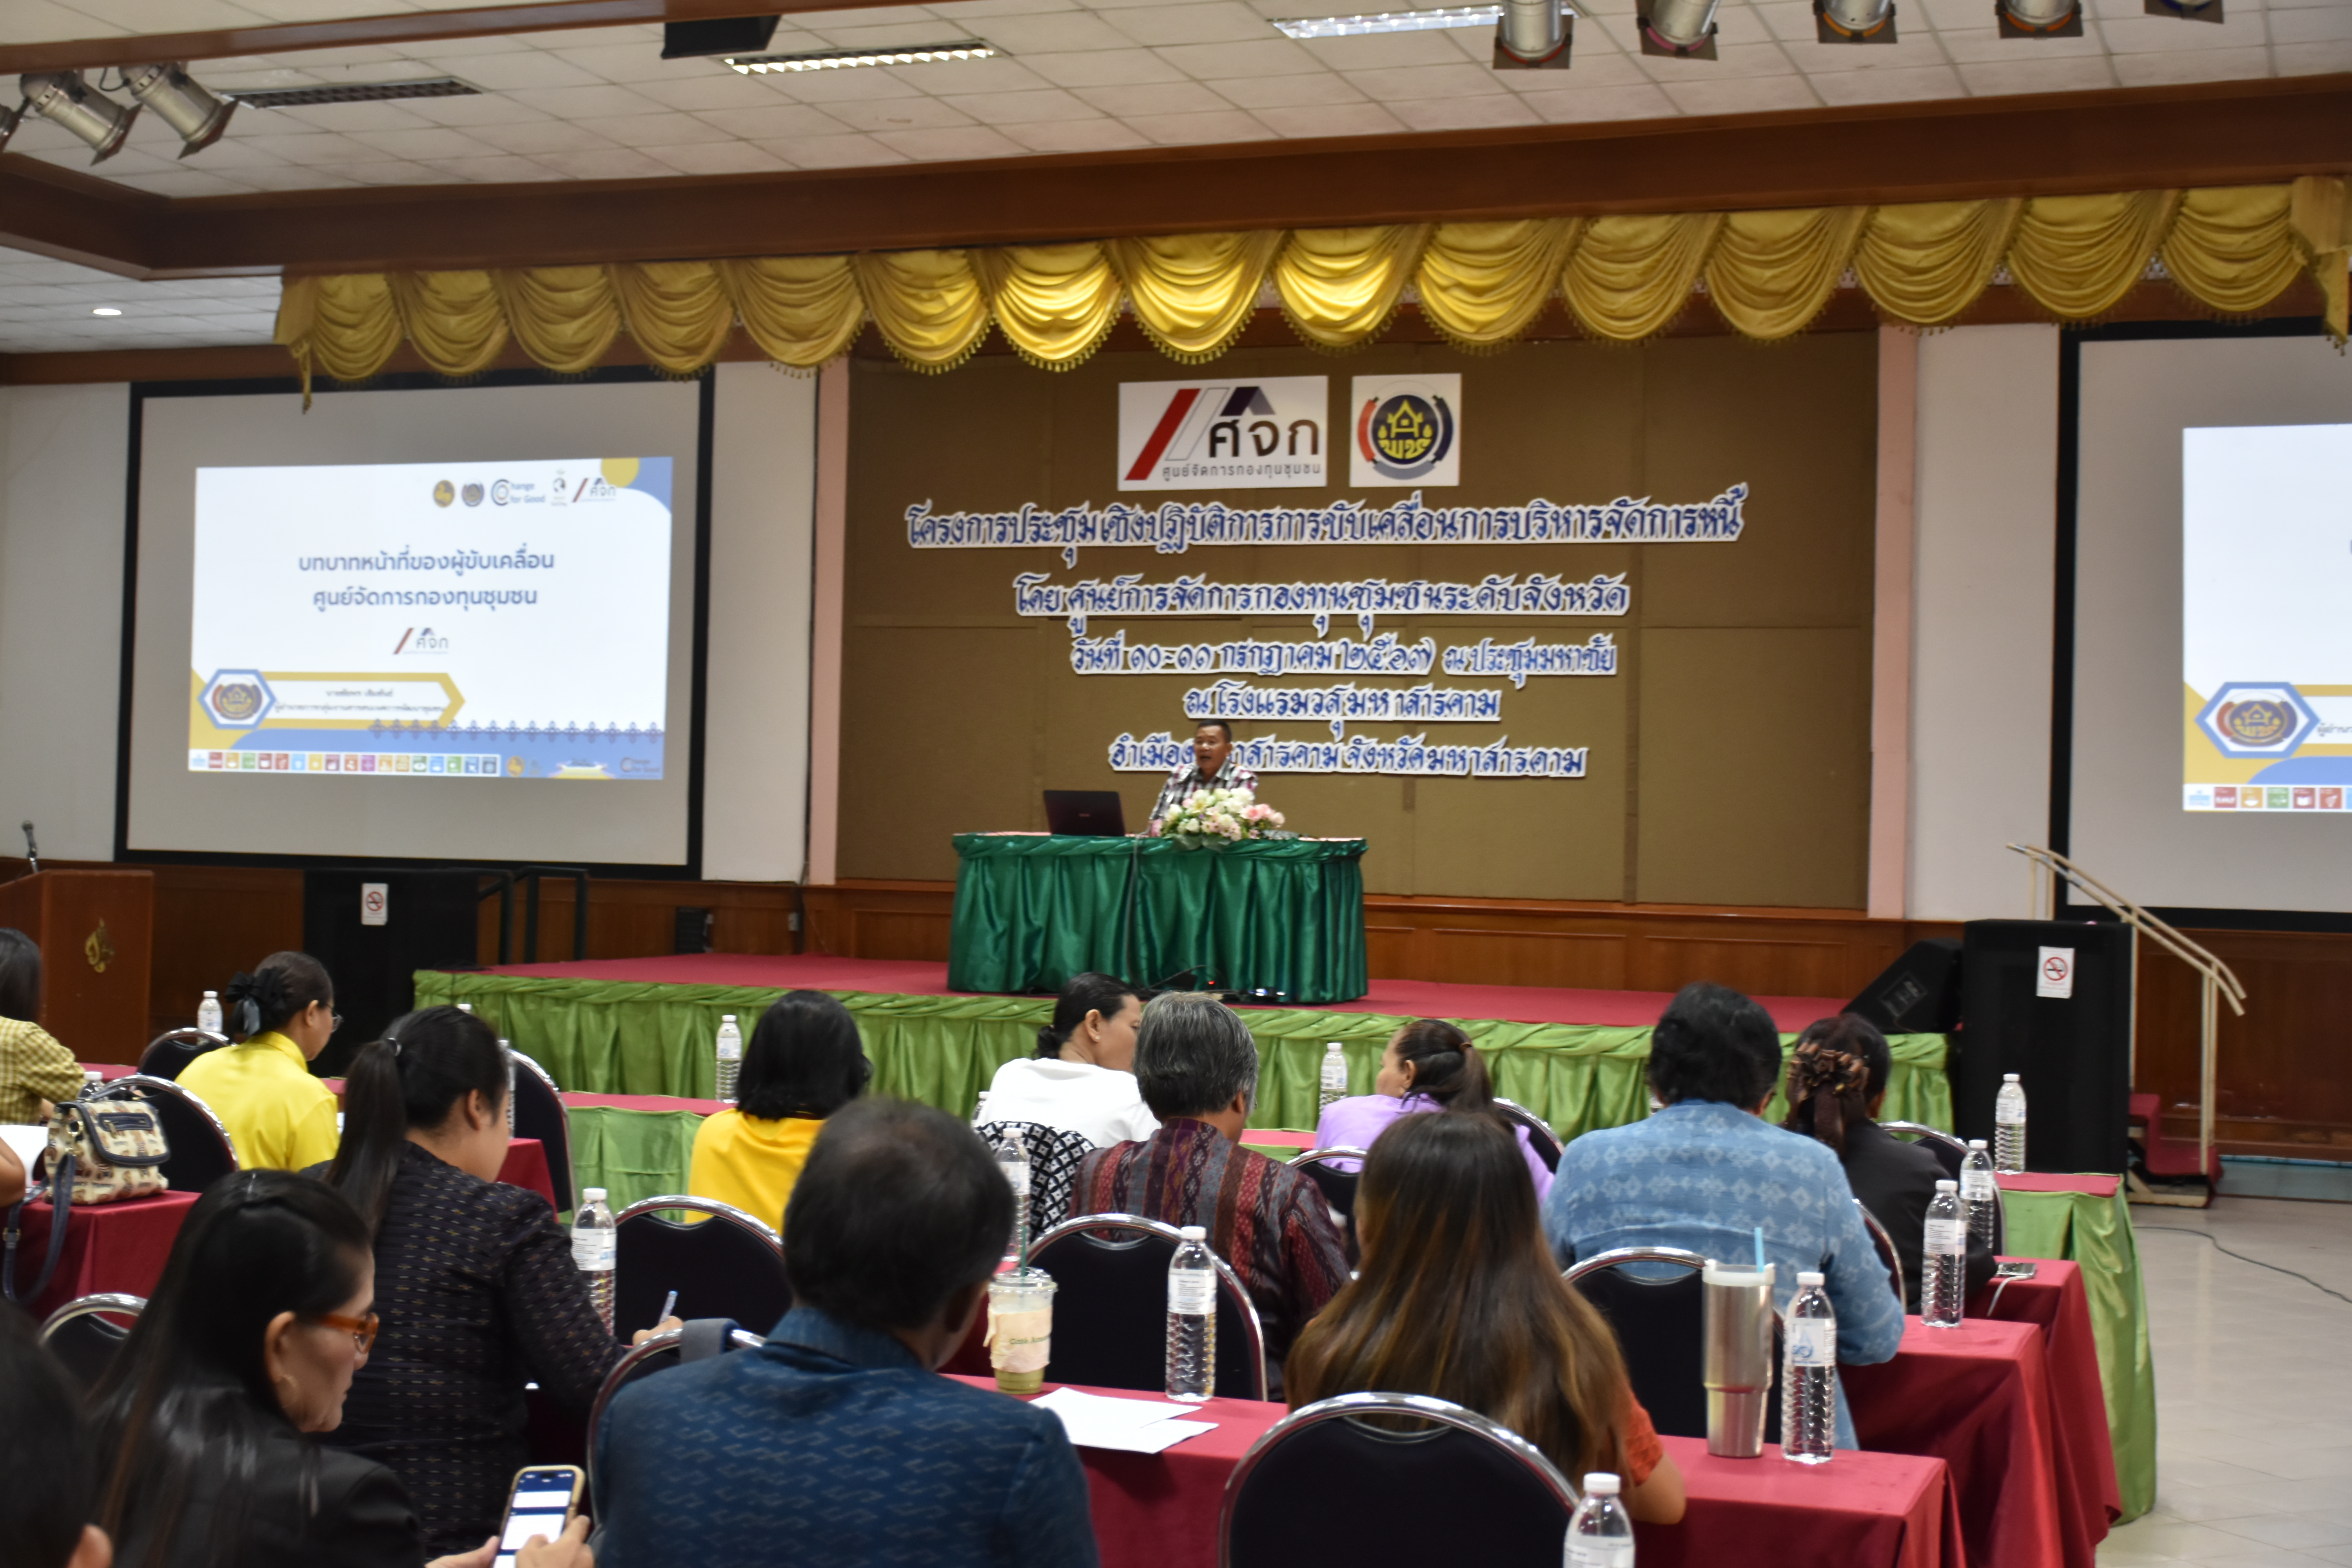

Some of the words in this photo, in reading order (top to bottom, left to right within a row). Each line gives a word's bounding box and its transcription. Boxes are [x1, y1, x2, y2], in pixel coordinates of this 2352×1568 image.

[1209, 418, 1319, 458] ศจก
[1162, 462, 1321, 482] ศูนย์จัดการกองทุนชุมชน
[298, 543, 555, 577] บทบาทหน้าที่ของผู้ขับเคลื่อน
[312, 585, 538, 612] ศูนย์จัดการกองทุนชุมชน
